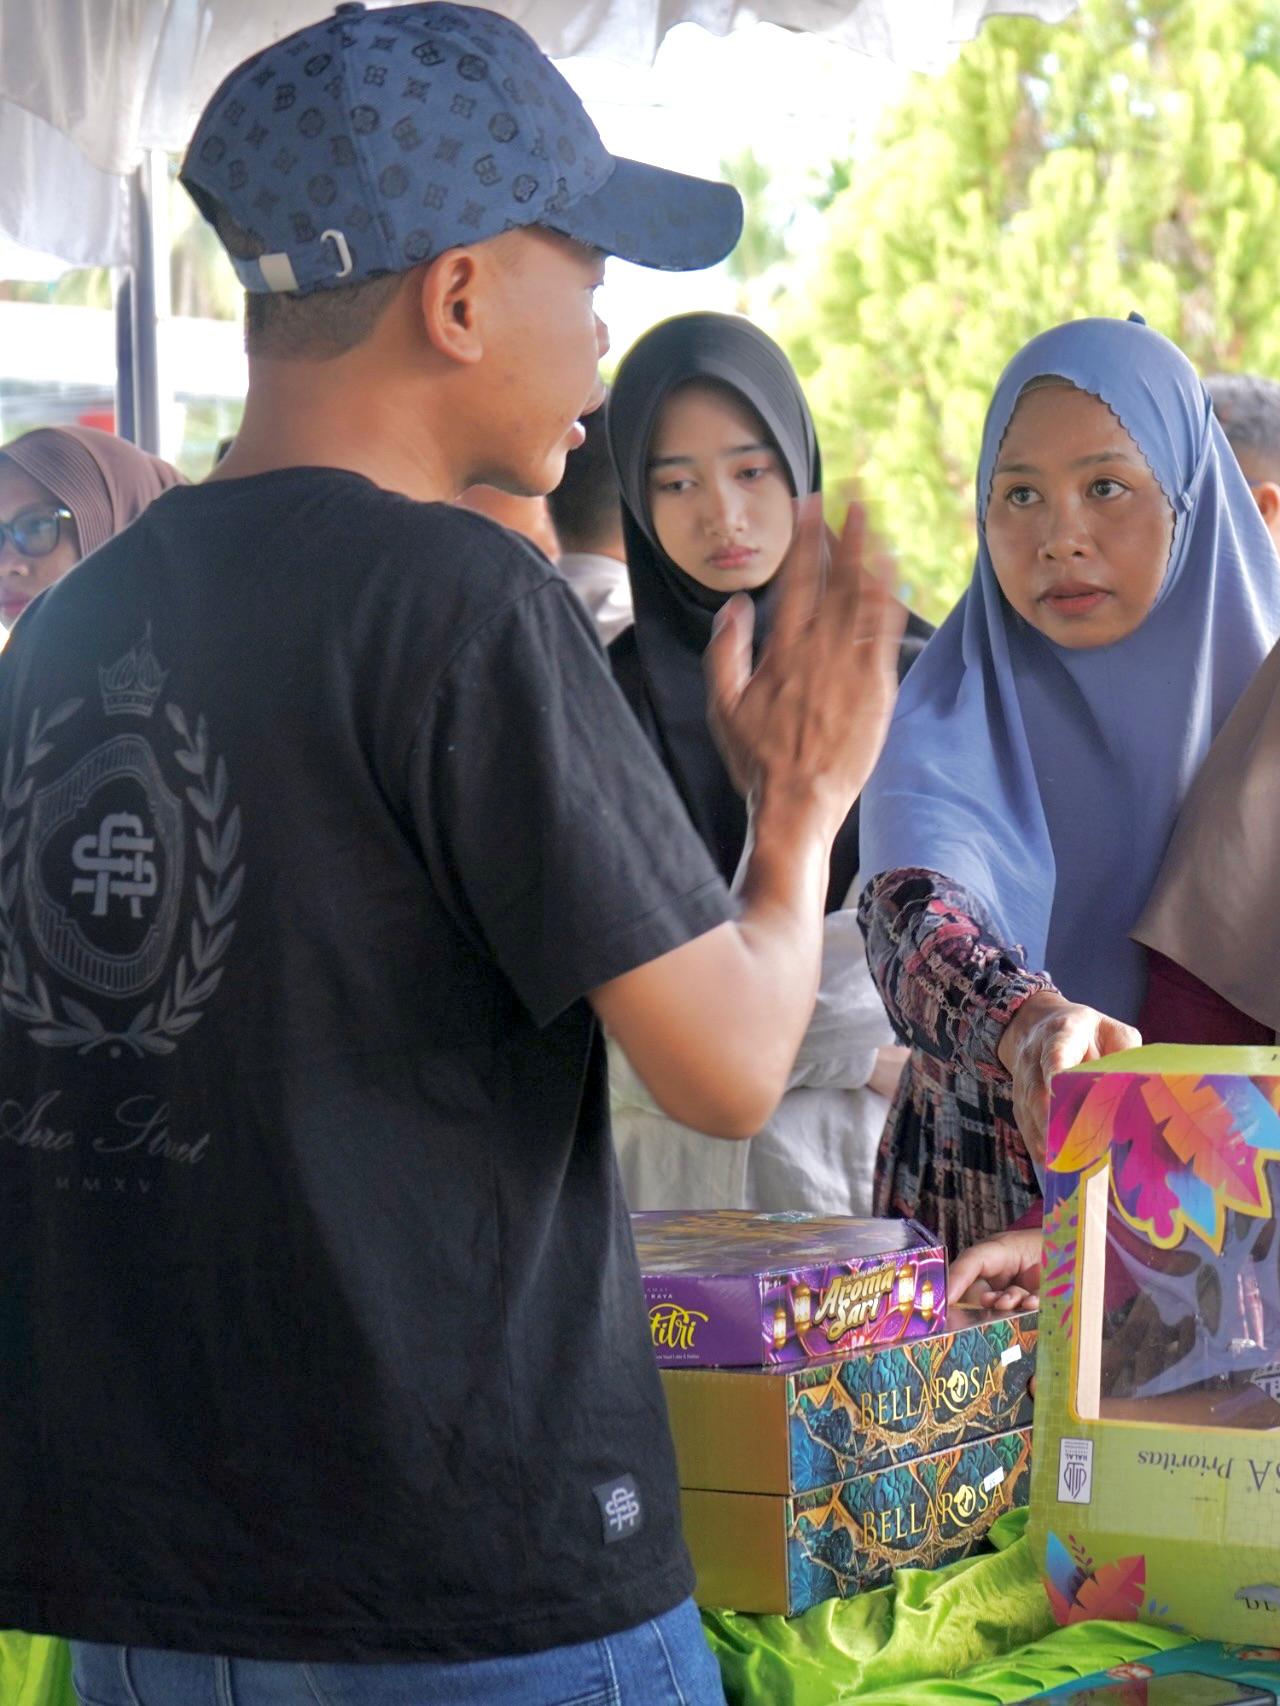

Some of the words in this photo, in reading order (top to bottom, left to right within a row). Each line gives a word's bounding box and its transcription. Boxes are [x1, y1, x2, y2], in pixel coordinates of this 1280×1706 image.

[813, 1268, 896, 1323] Aroma
[827, 1292, 882, 1341] Sari
[860, 1363, 997, 1431] BELLAROSA
[1137, 1450, 1235, 1480] Prioritas
[862, 1482, 1005, 1548] BELLAROSA
